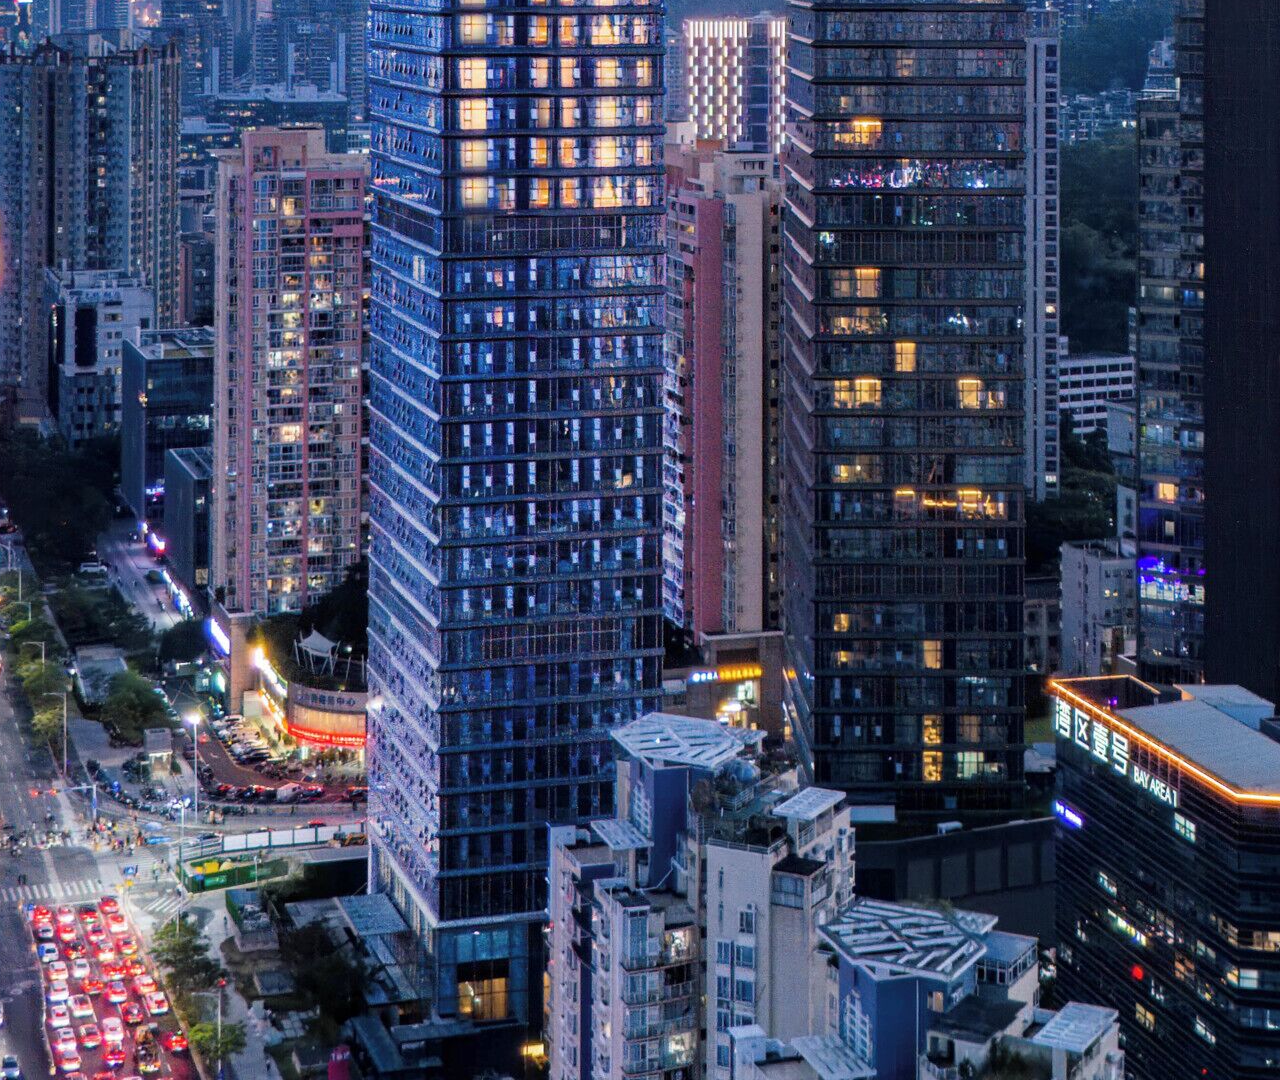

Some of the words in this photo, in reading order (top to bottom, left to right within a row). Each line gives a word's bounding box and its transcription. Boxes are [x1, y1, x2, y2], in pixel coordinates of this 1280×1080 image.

[1055, 696, 1130, 775] 湾区壹号
[1133, 765, 1150, 789] BAY
[1150, 778, 1172, 805] AREA
